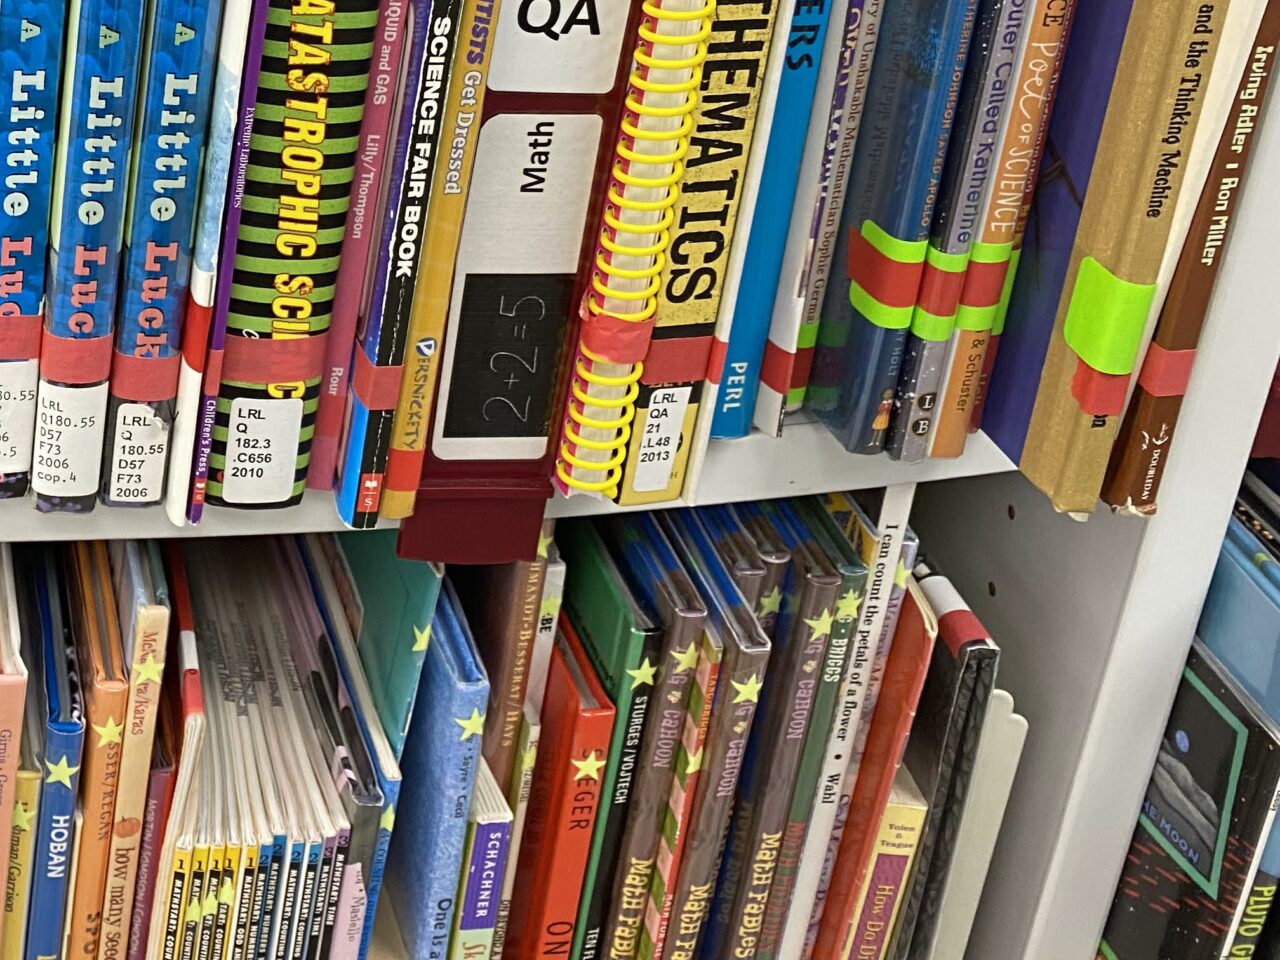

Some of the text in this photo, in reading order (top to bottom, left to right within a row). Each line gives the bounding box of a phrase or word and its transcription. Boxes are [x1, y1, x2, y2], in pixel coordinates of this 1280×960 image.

[1192, 3, 1215, 34] and
[1184, 35, 1209, 69] the
[460, 70, 481, 106] Get
[1162, 72, 1202, 148] Thinking
[3, 70, 46, 217] Little
[78, 76, 124, 225] Little
[150, 73, 198, 222] Little
[395, 17, 452, 278] SCIENCE FAIR BOOK
[444, 112, 474, 195] Dressed
[520, 121, 555, 194] Math
[1145, 149, 1180, 220] Machine
[722, 361, 748, 413] PERL
[236, 423, 248, 434] Q
[238, 409, 266, 419] LRL
[233, 453, 272, 463] .C656
[236, 438, 271, 449] 182.3
[231, 467, 264, 478] 2010
[883, 532, 892, 558] can
[869, 560, 888, 601] count
[864, 601, 878, 626] the
[824, 638, 848, 684] BRIGGS
[854, 628, 872, 669] petals
[849, 672, 864, 687] of
[837, 699, 858, 742] flower
[822, 773, 841, 804] Wahl
[47, 814, 70, 879] HOBAN
[474, 832, 502, 918] SCHACHNER
[1238, 885, 1277, 938] PLUTO
